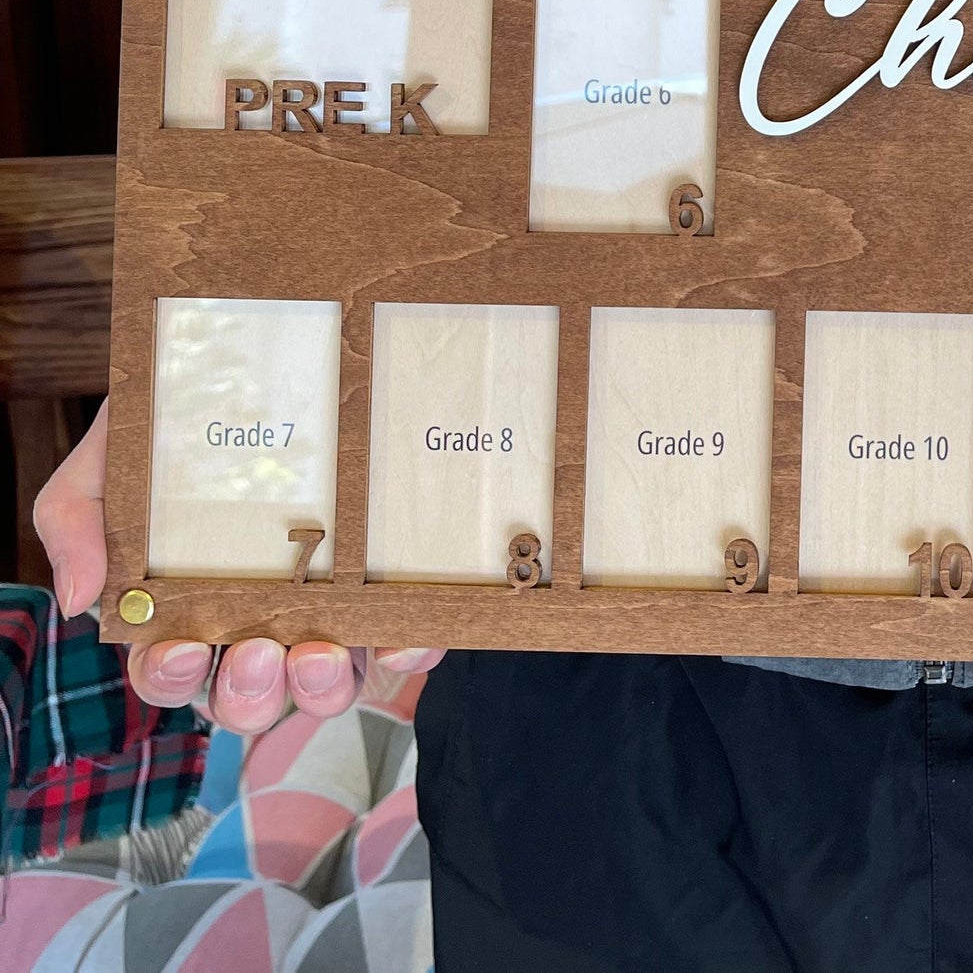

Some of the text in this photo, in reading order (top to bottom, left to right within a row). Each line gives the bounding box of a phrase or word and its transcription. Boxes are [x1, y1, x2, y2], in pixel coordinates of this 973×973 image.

[225, 78, 440, 134] PRE K
[584, 79, 672, 105] Grade 6
[669, 184, 704, 236] 6
[206, 421, 295, 447] Grade 7
[425, 426, 513, 452] Grade 8
[637, 430, 724, 457] Grade 9
[848, 434, 949, 461] Grade 10
[287, 529, 325, 583] 7
[506, 534, 542, 589] 8
[724, 538, 760, 593] 9
[908, 542, 973, 599] 10
